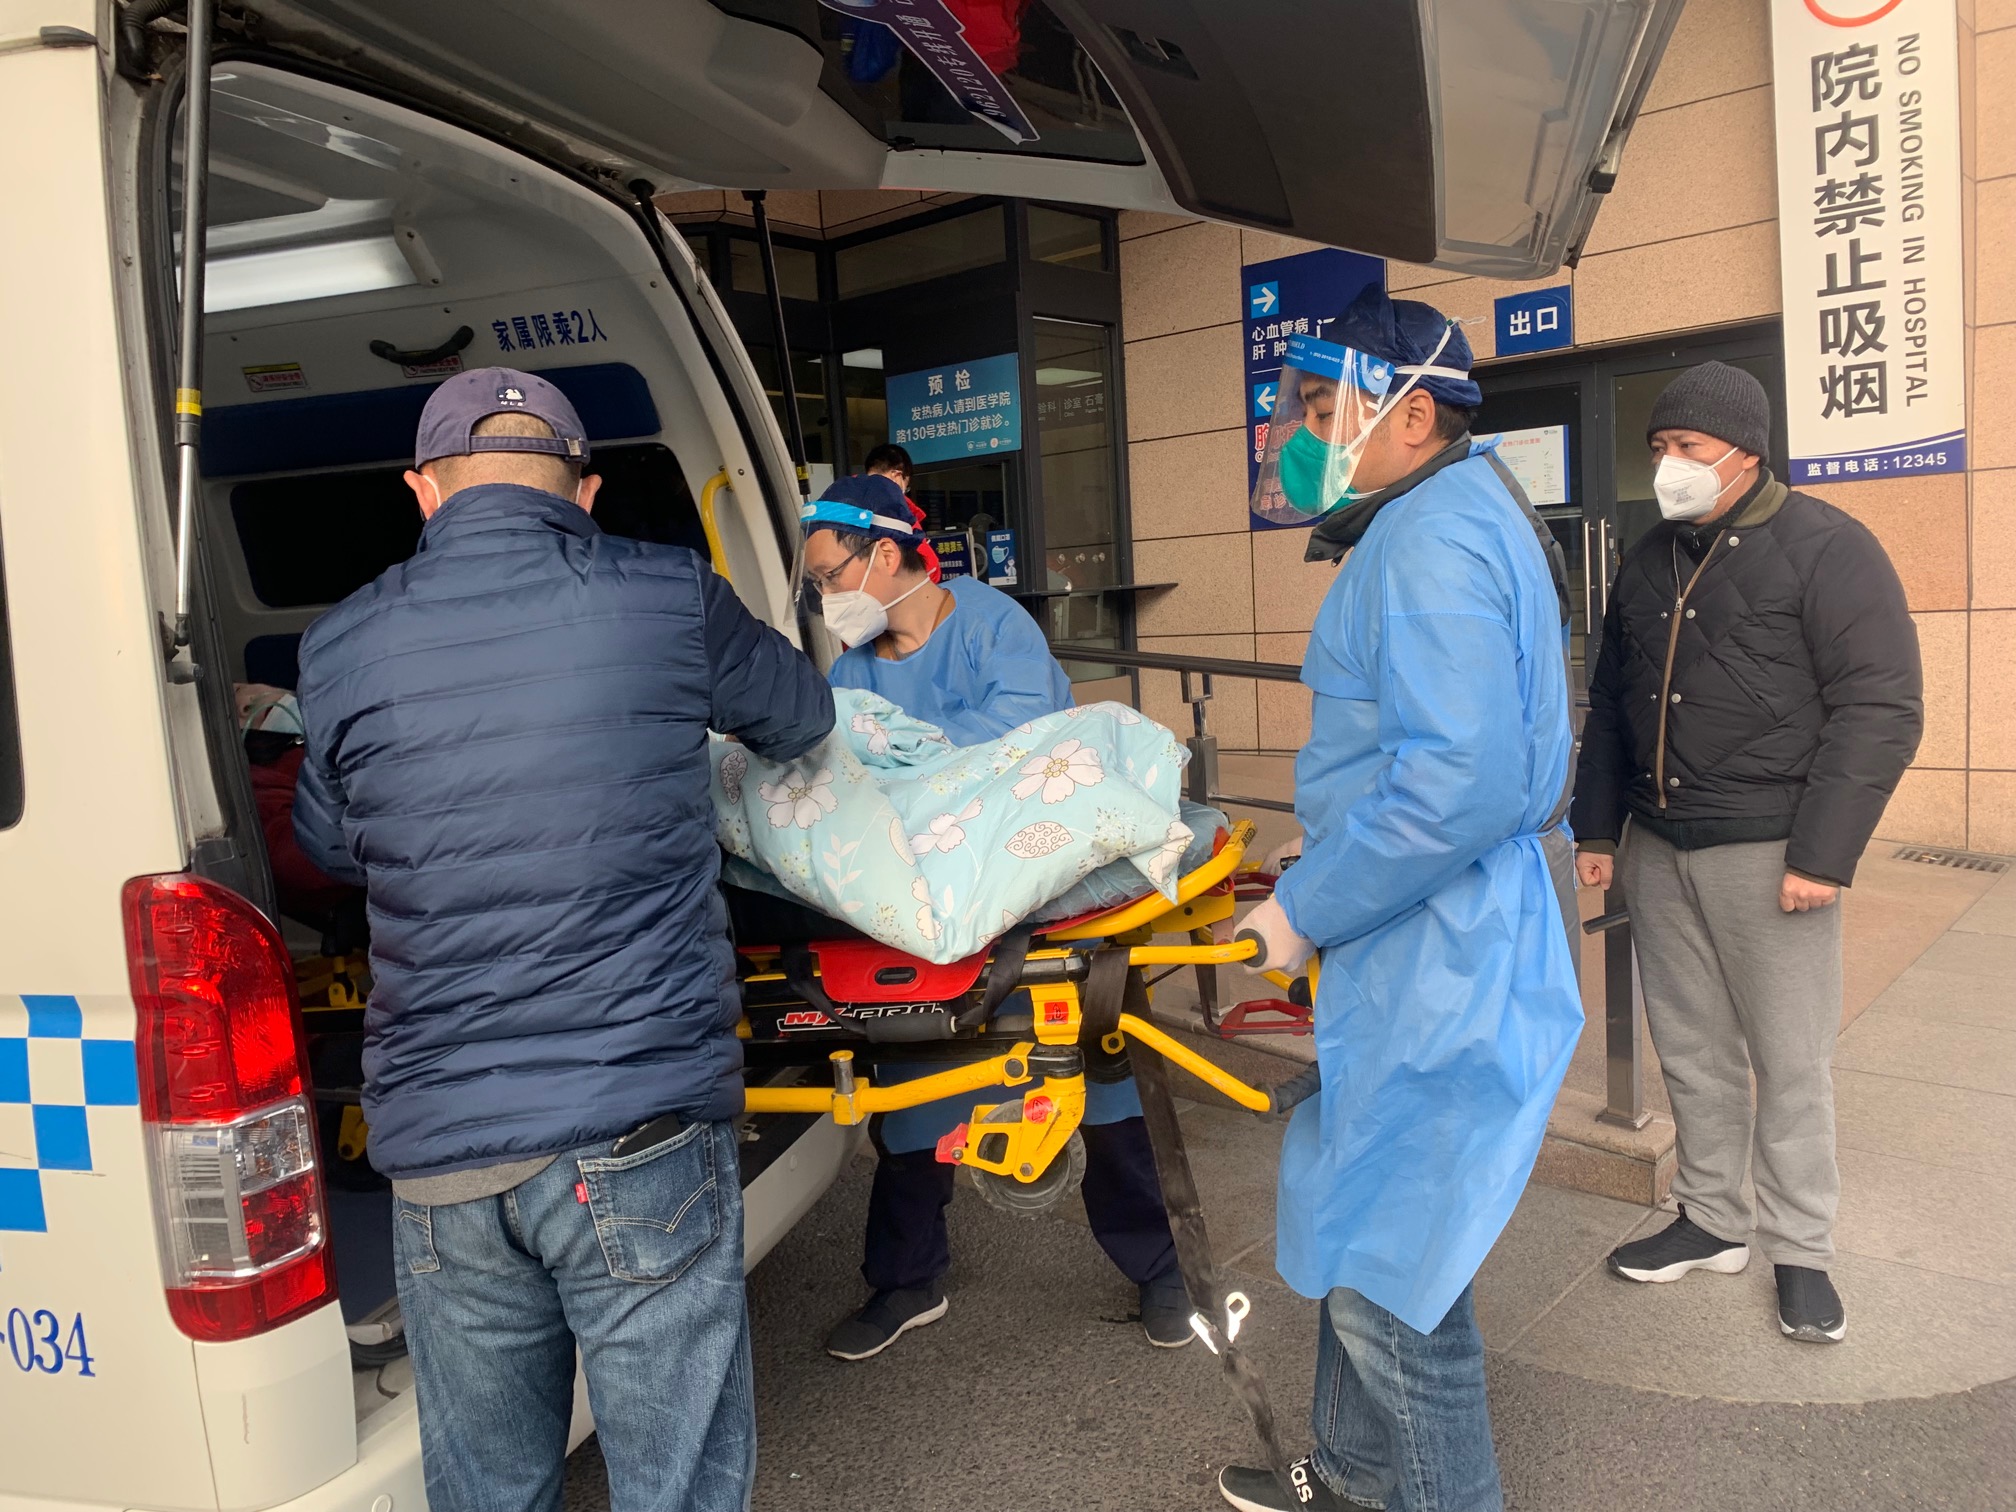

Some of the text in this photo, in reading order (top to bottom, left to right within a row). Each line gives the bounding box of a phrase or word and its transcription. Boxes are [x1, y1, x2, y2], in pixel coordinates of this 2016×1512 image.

[1811, 43, 1888, 420] 院内禁止吸烟
[1898, 33, 1928, 407] NO SMOKING IN HOSPITAL
[492, 308, 608, 353] 家属限乘2人
[1252, 318, 1309, 341] 心血管病
[1509, 306, 1558, 336] 出口
[928, 369, 971, 396] 预检
[911, 391, 1011, 421] 发热病人请到医学院
[896, 413, 1010, 444] 路130号发热门诊就诊。
